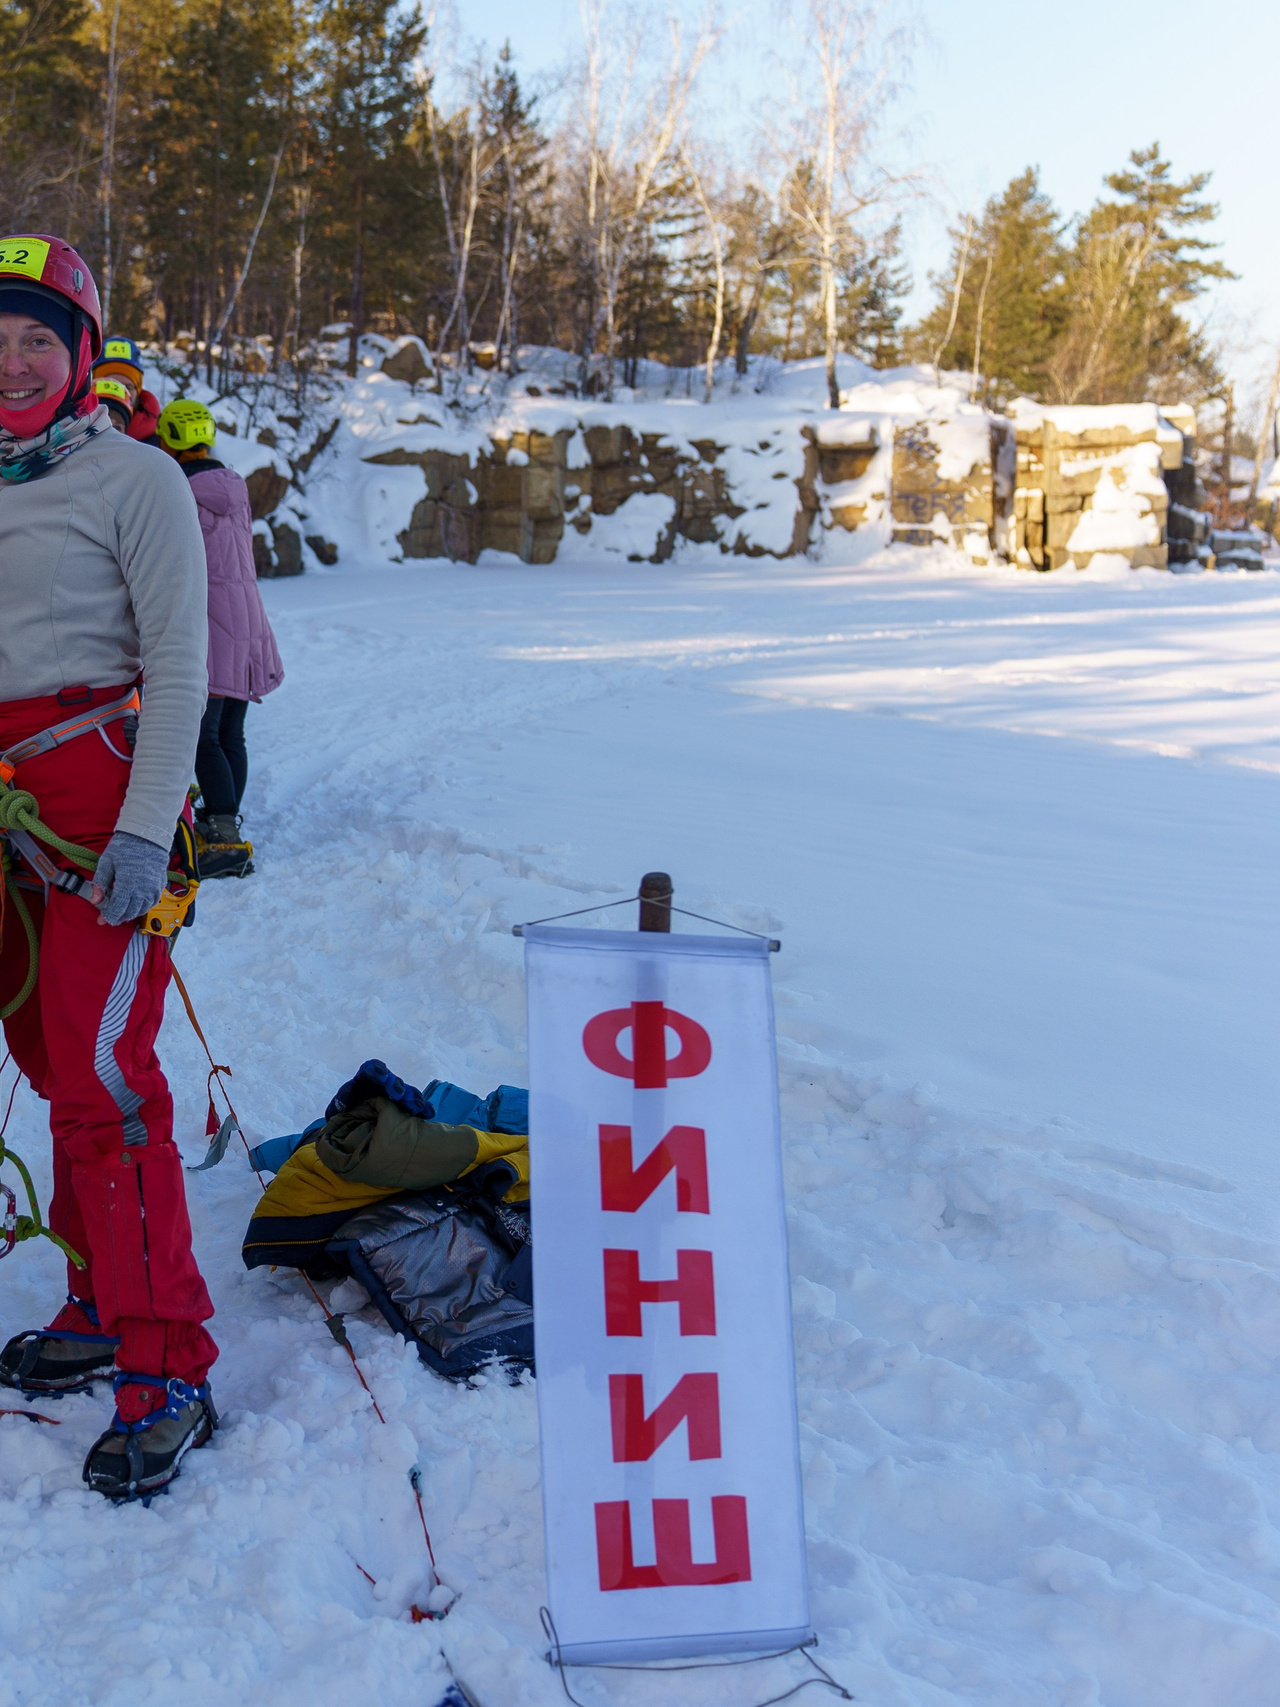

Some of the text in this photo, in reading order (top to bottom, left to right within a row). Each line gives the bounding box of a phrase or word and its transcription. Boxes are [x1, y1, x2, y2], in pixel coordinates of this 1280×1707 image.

[112, 345, 126, 354] 4.1
[194, 426, 207, 437] 1.1
[582, 1000, 752, 1592] ФИНИШ
